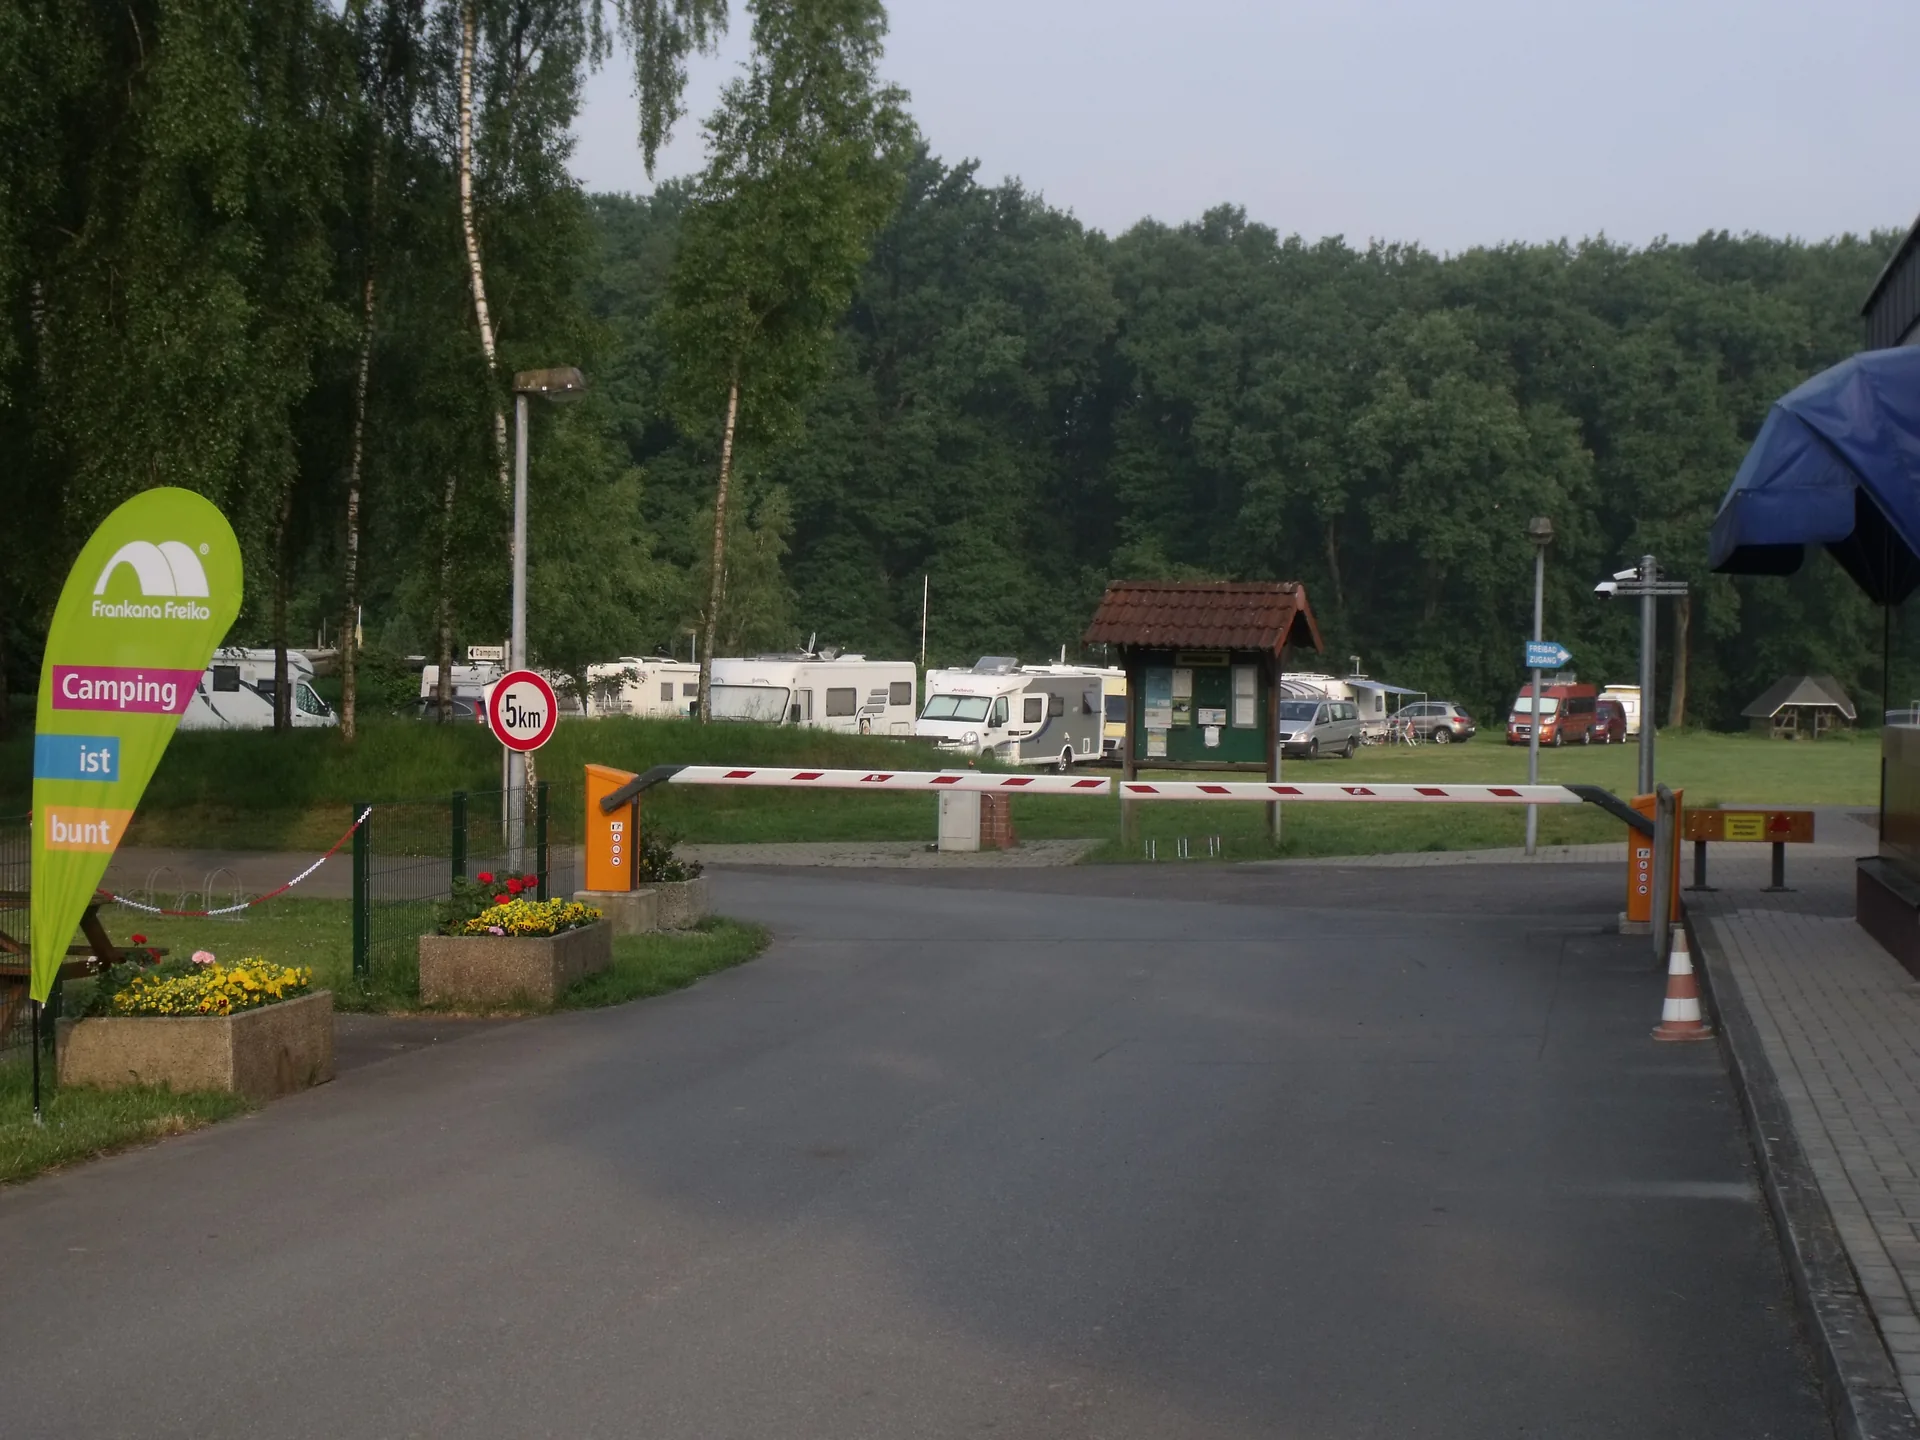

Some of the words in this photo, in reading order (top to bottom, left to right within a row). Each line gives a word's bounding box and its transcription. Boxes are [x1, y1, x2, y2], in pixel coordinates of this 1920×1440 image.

[92, 600, 162, 619] Frankana
[164, 601, 210, 620] Freiko
[475, 647, 500, 659] Camping
[1529, 644, 1558, 654] FREIBAD
[1529, 655, 1557, 664] ZUGANG
[62, 673, 177, 711] Camping
[505, 694, 541, 728] 5km
[80, 744, 111, 773] ist
[52, 814, 111, 845] bunt
